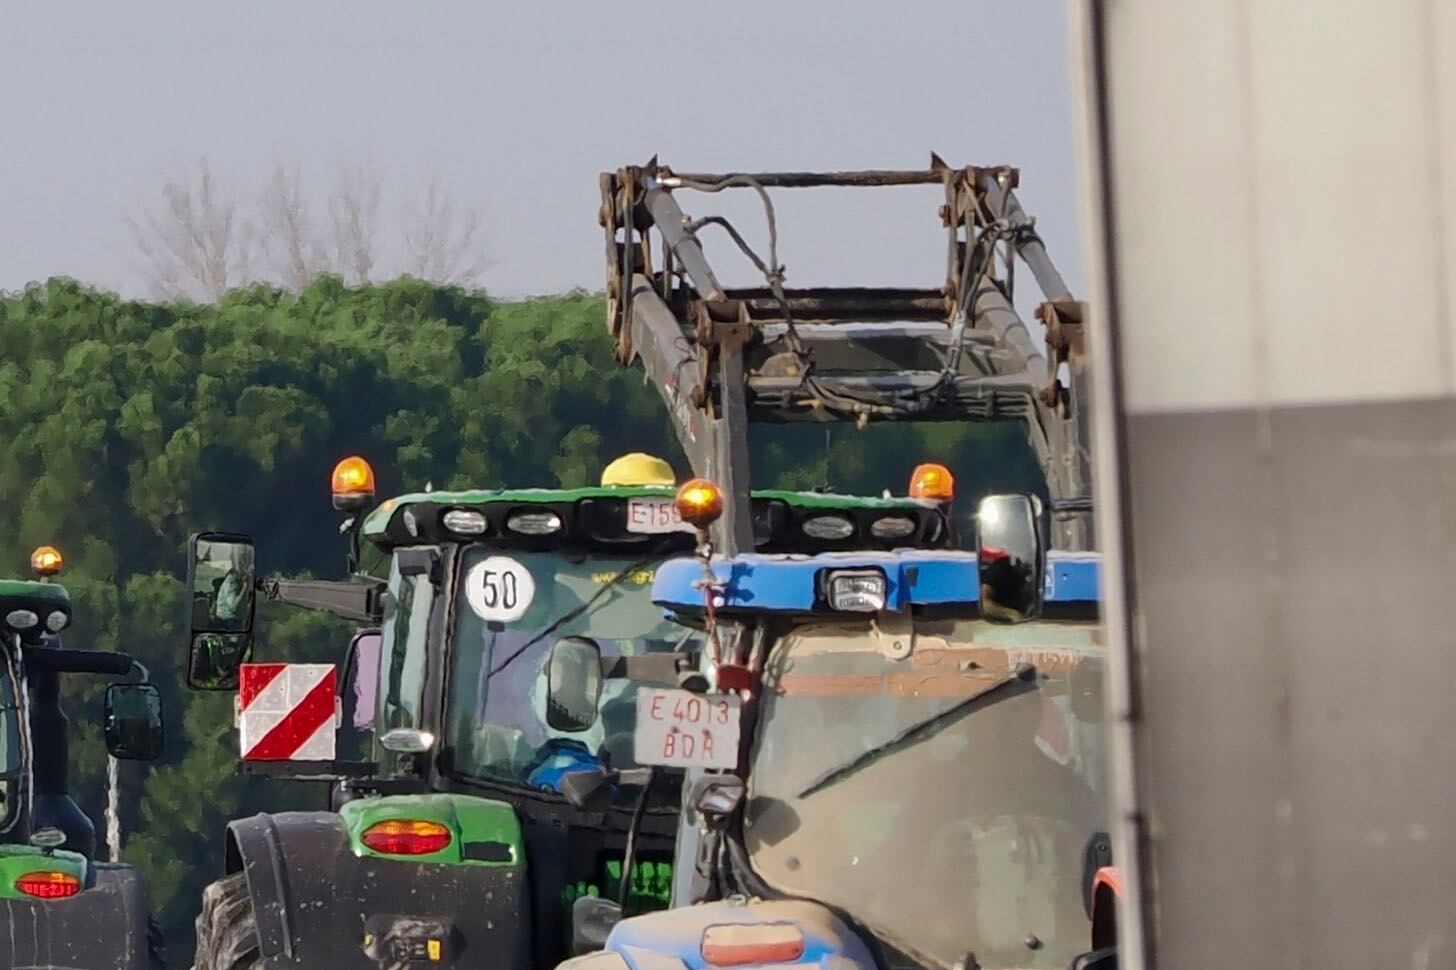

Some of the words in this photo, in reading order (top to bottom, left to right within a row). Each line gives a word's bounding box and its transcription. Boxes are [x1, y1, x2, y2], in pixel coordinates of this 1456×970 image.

[482, 570, 517, 609] 50
[650, 694, 666, 721] E
[672, 697, 730, 725] 4013
